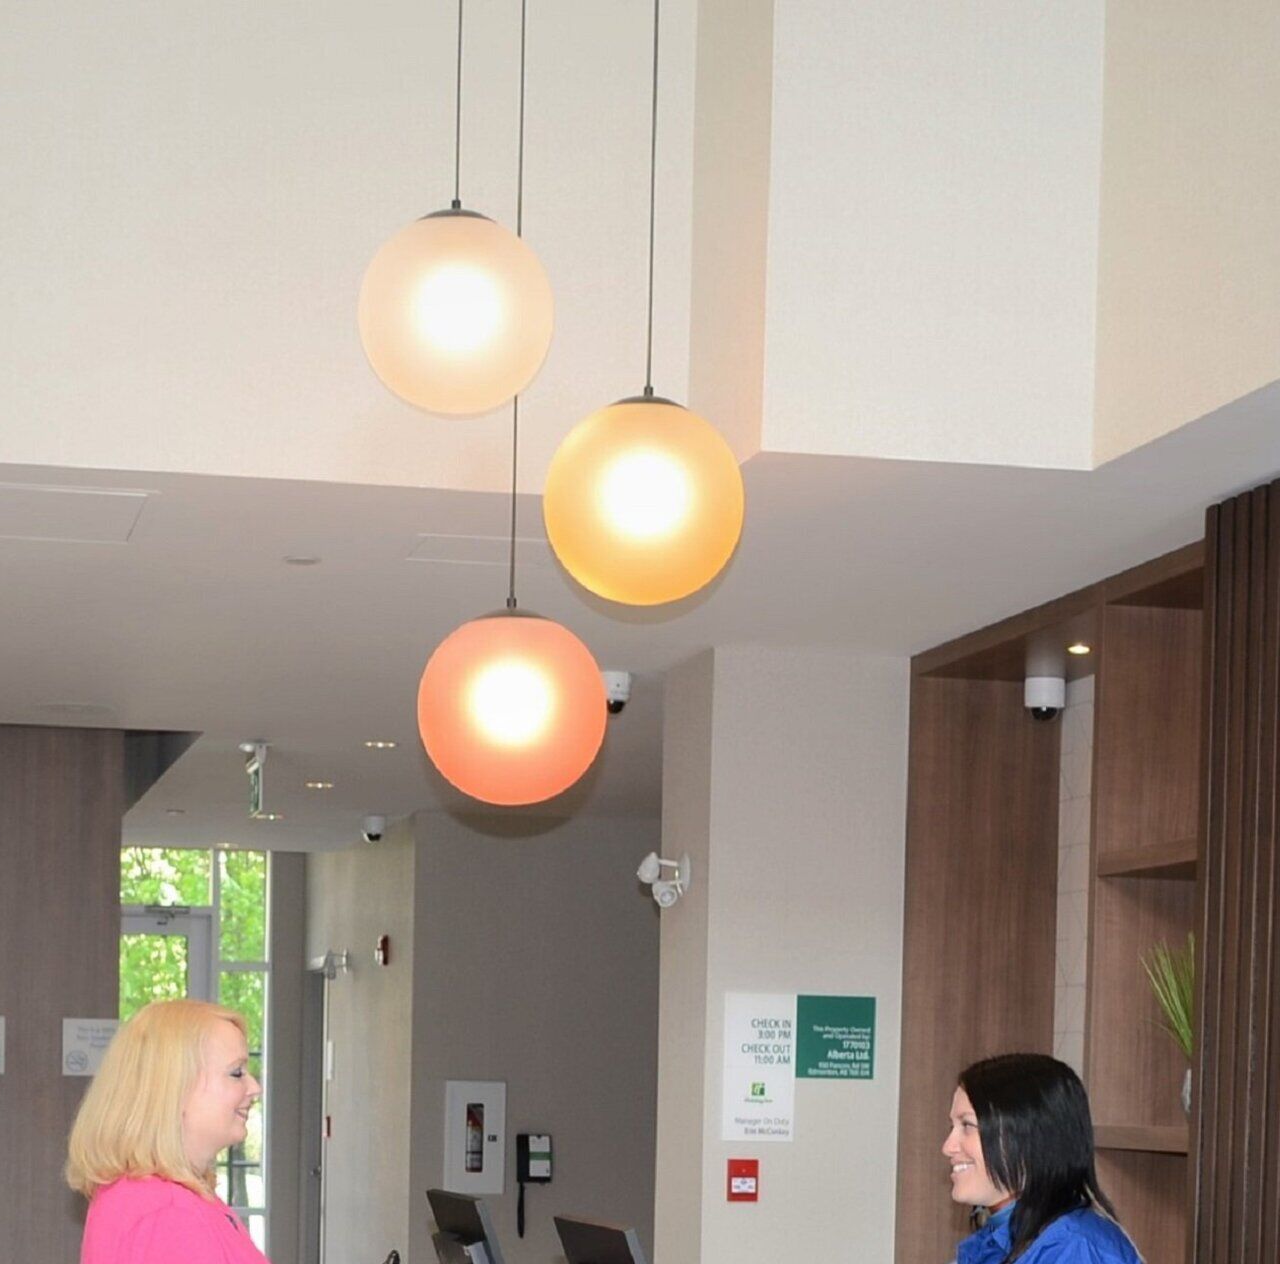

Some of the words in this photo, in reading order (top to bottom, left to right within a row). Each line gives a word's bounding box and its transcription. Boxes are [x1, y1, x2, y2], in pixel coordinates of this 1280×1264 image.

[751, 1018, 780, 1028] CHECK
[782, 1019, 791, 1028] IN
[758, 1030, 776, 1039] 3:00
[778, 1030, 791, 1040] PM
[741, 1043, 770, 1053] CHECK
[772, 1044, 791, 1054] OUT
[754, 1055, 774, 1064] 11:00
[776, 1055, 791, 1064] AM
[827, 1050, 854, 1060] Alberta
